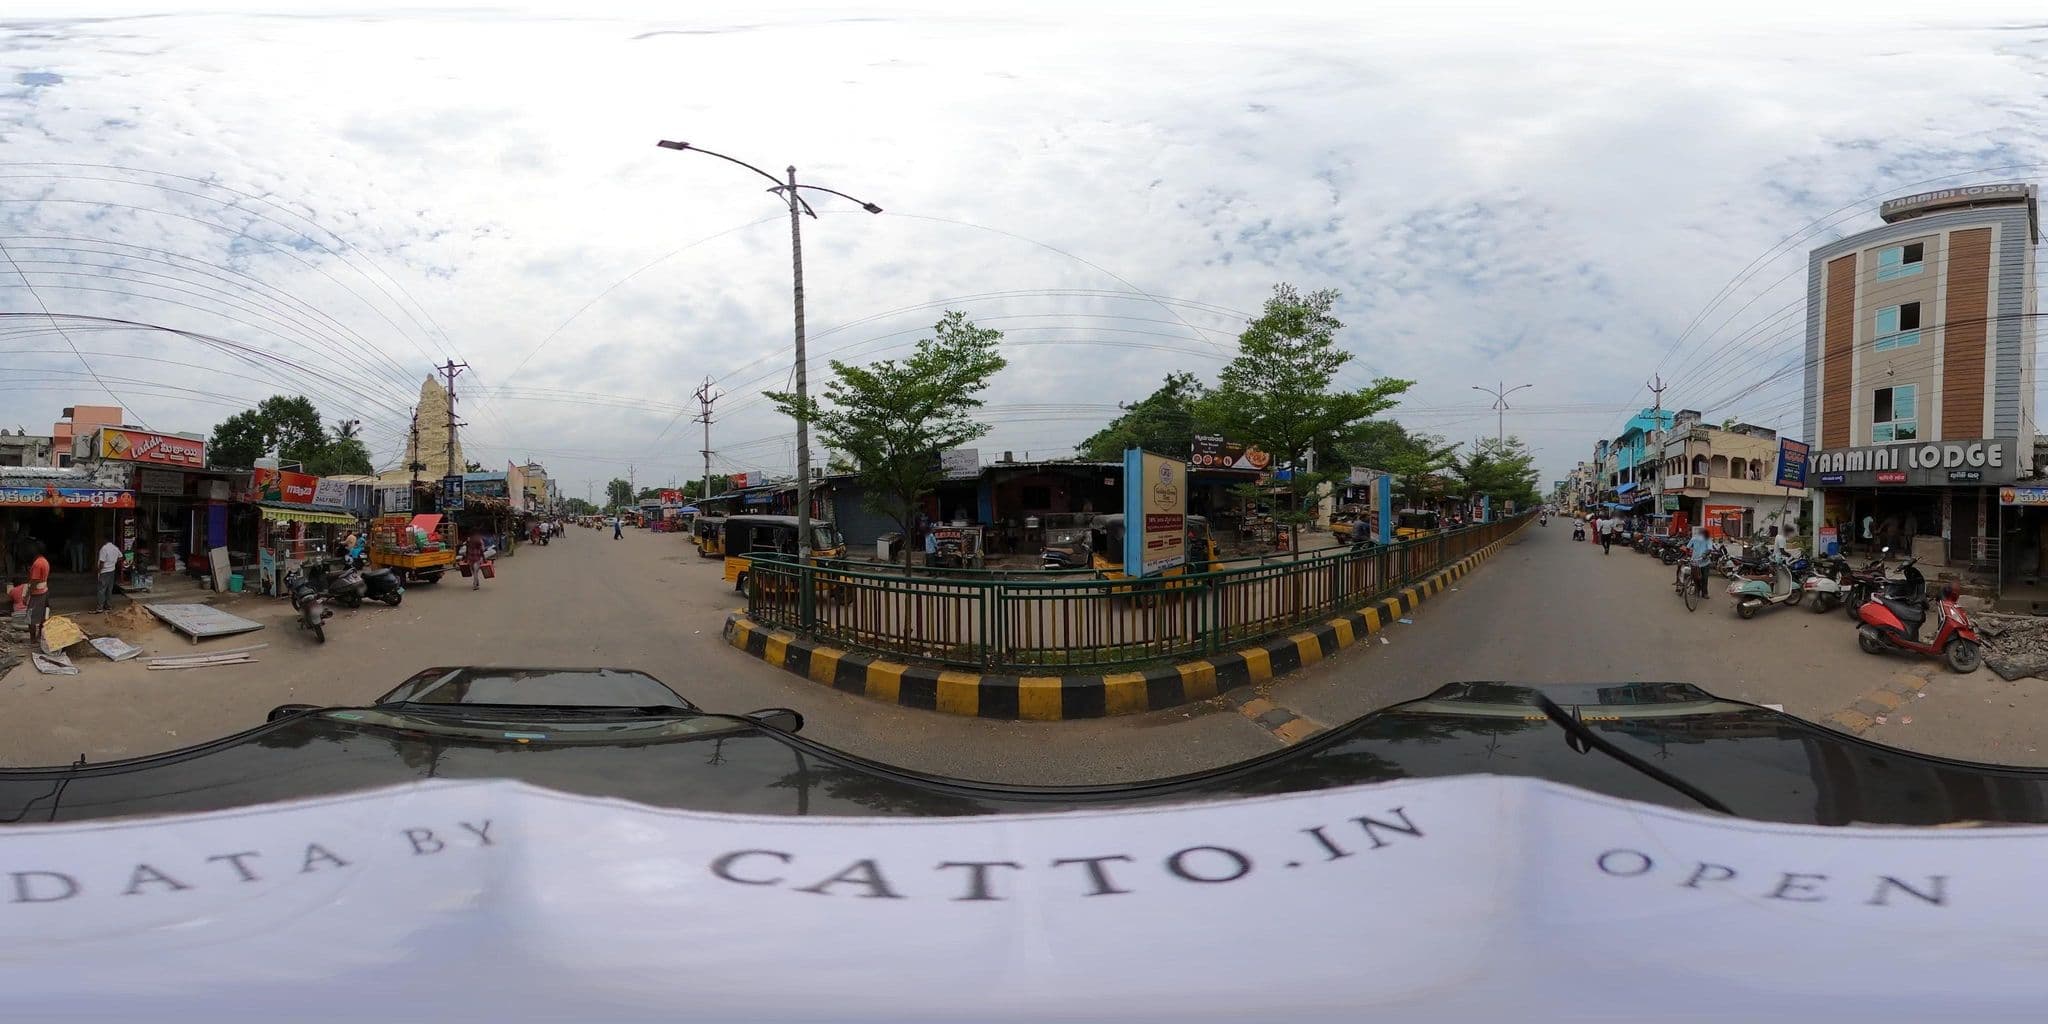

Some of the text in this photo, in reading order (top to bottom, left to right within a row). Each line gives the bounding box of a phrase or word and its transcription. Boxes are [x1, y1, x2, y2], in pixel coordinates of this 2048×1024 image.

[1888, 184, 2021, 209] YAAMINI LODGE
[130, 435, 163, 459] Laddu
[1808, 447, 1899, 475] YAAMINI
[1908, 443, 2003, 469] LODGE
[8, 819, 501, 904] DATA BY
[709, 805, 1428, 903] CATTO.IN
[1594, 847, 1952, 907] OPEN
